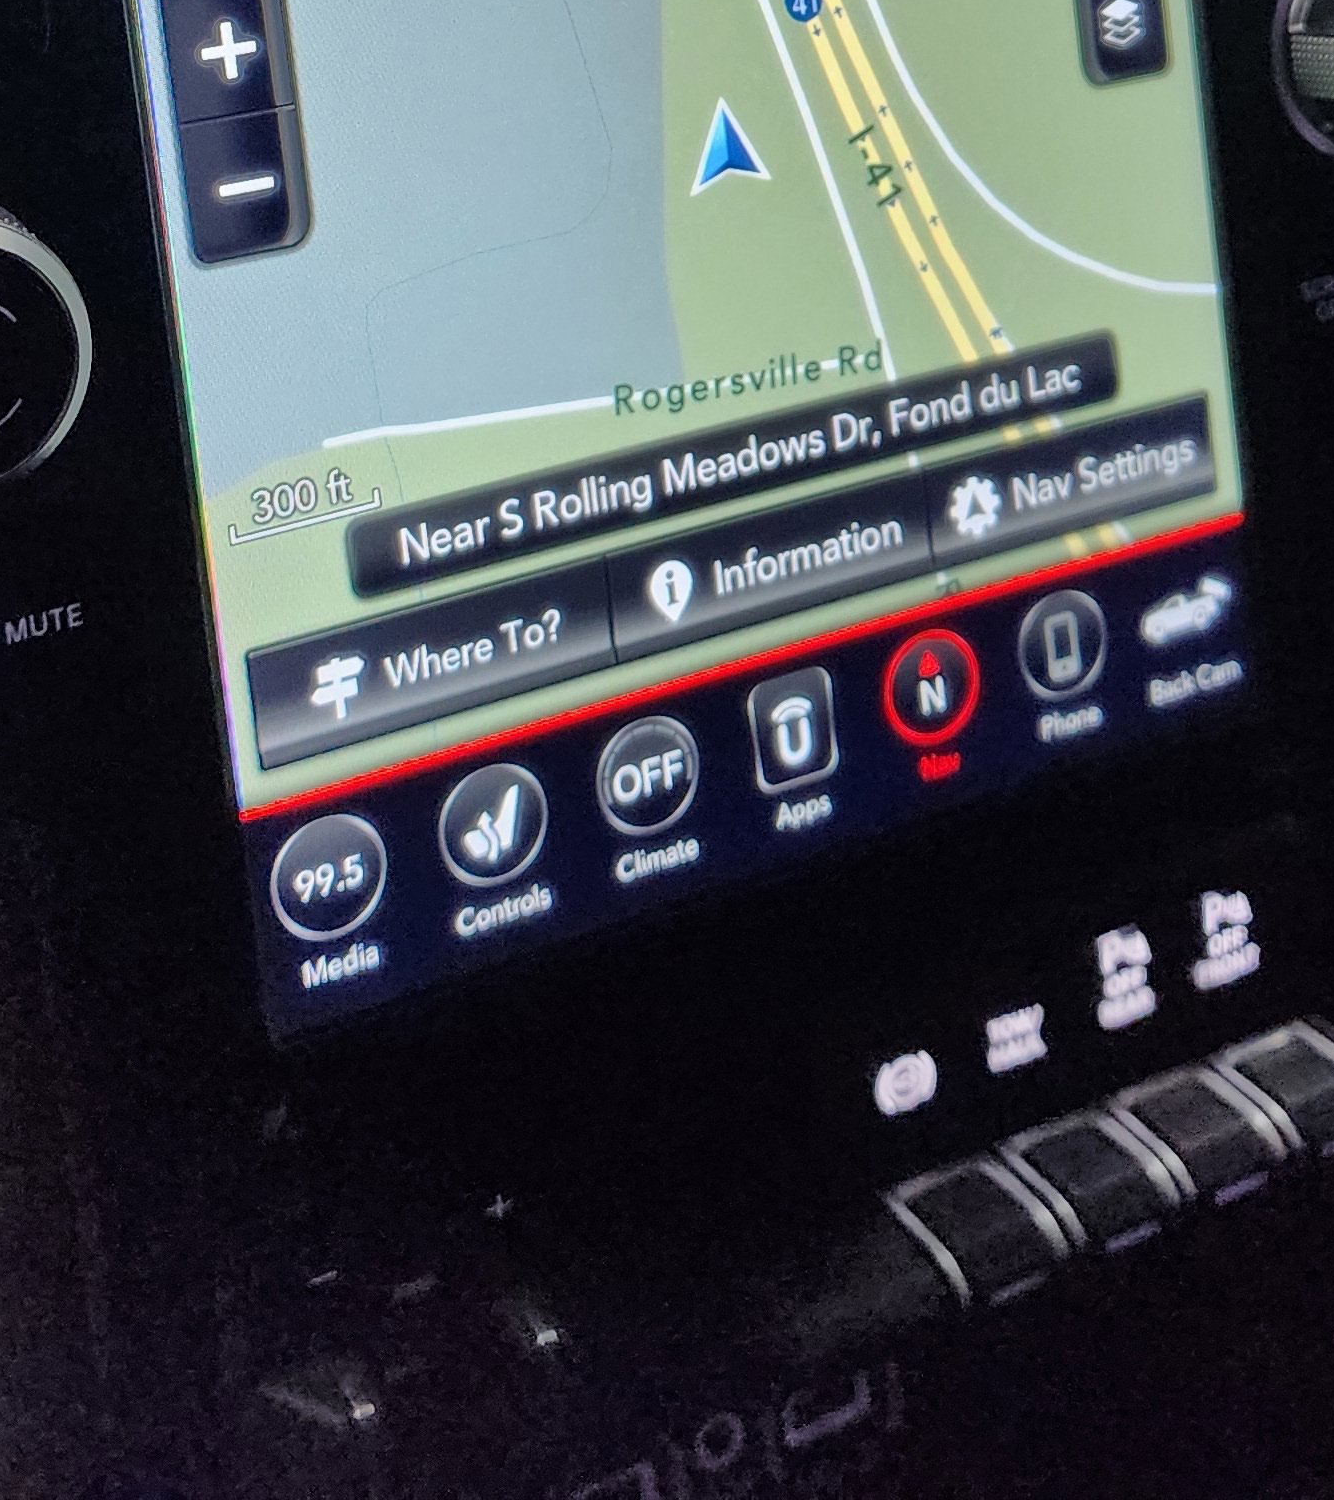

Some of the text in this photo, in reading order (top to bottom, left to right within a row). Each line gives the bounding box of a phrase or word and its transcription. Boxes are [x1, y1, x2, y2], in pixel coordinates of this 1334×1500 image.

[615, 339, 883, 416] Rogersville Rd
[398, 363, 1083, 567] Near S Rolling Meadows Dr, Fond du Lac
[1011, 438, 1197, 511] Nav Settings
[252, 468, 354, 524] 300 ft
[714, 518, 904, 597] Information
[3, 602, 84, 645] MUTE
[383, 608, 562, 689] Where To?
[917, 674, 948, 716] N
[1148, 658, 1244, 708] Back Cam
[1038, 705, 1104, 743] Phone
[612, 748, 684, 806] OFF
[774, 794, 834, 832] Apps
[292, 852, 365, 904] 99.5
[614, 836, 700, 884] Climate
[453, 883, 554, 937] Controls
[299, 940, 381, 990] Media
